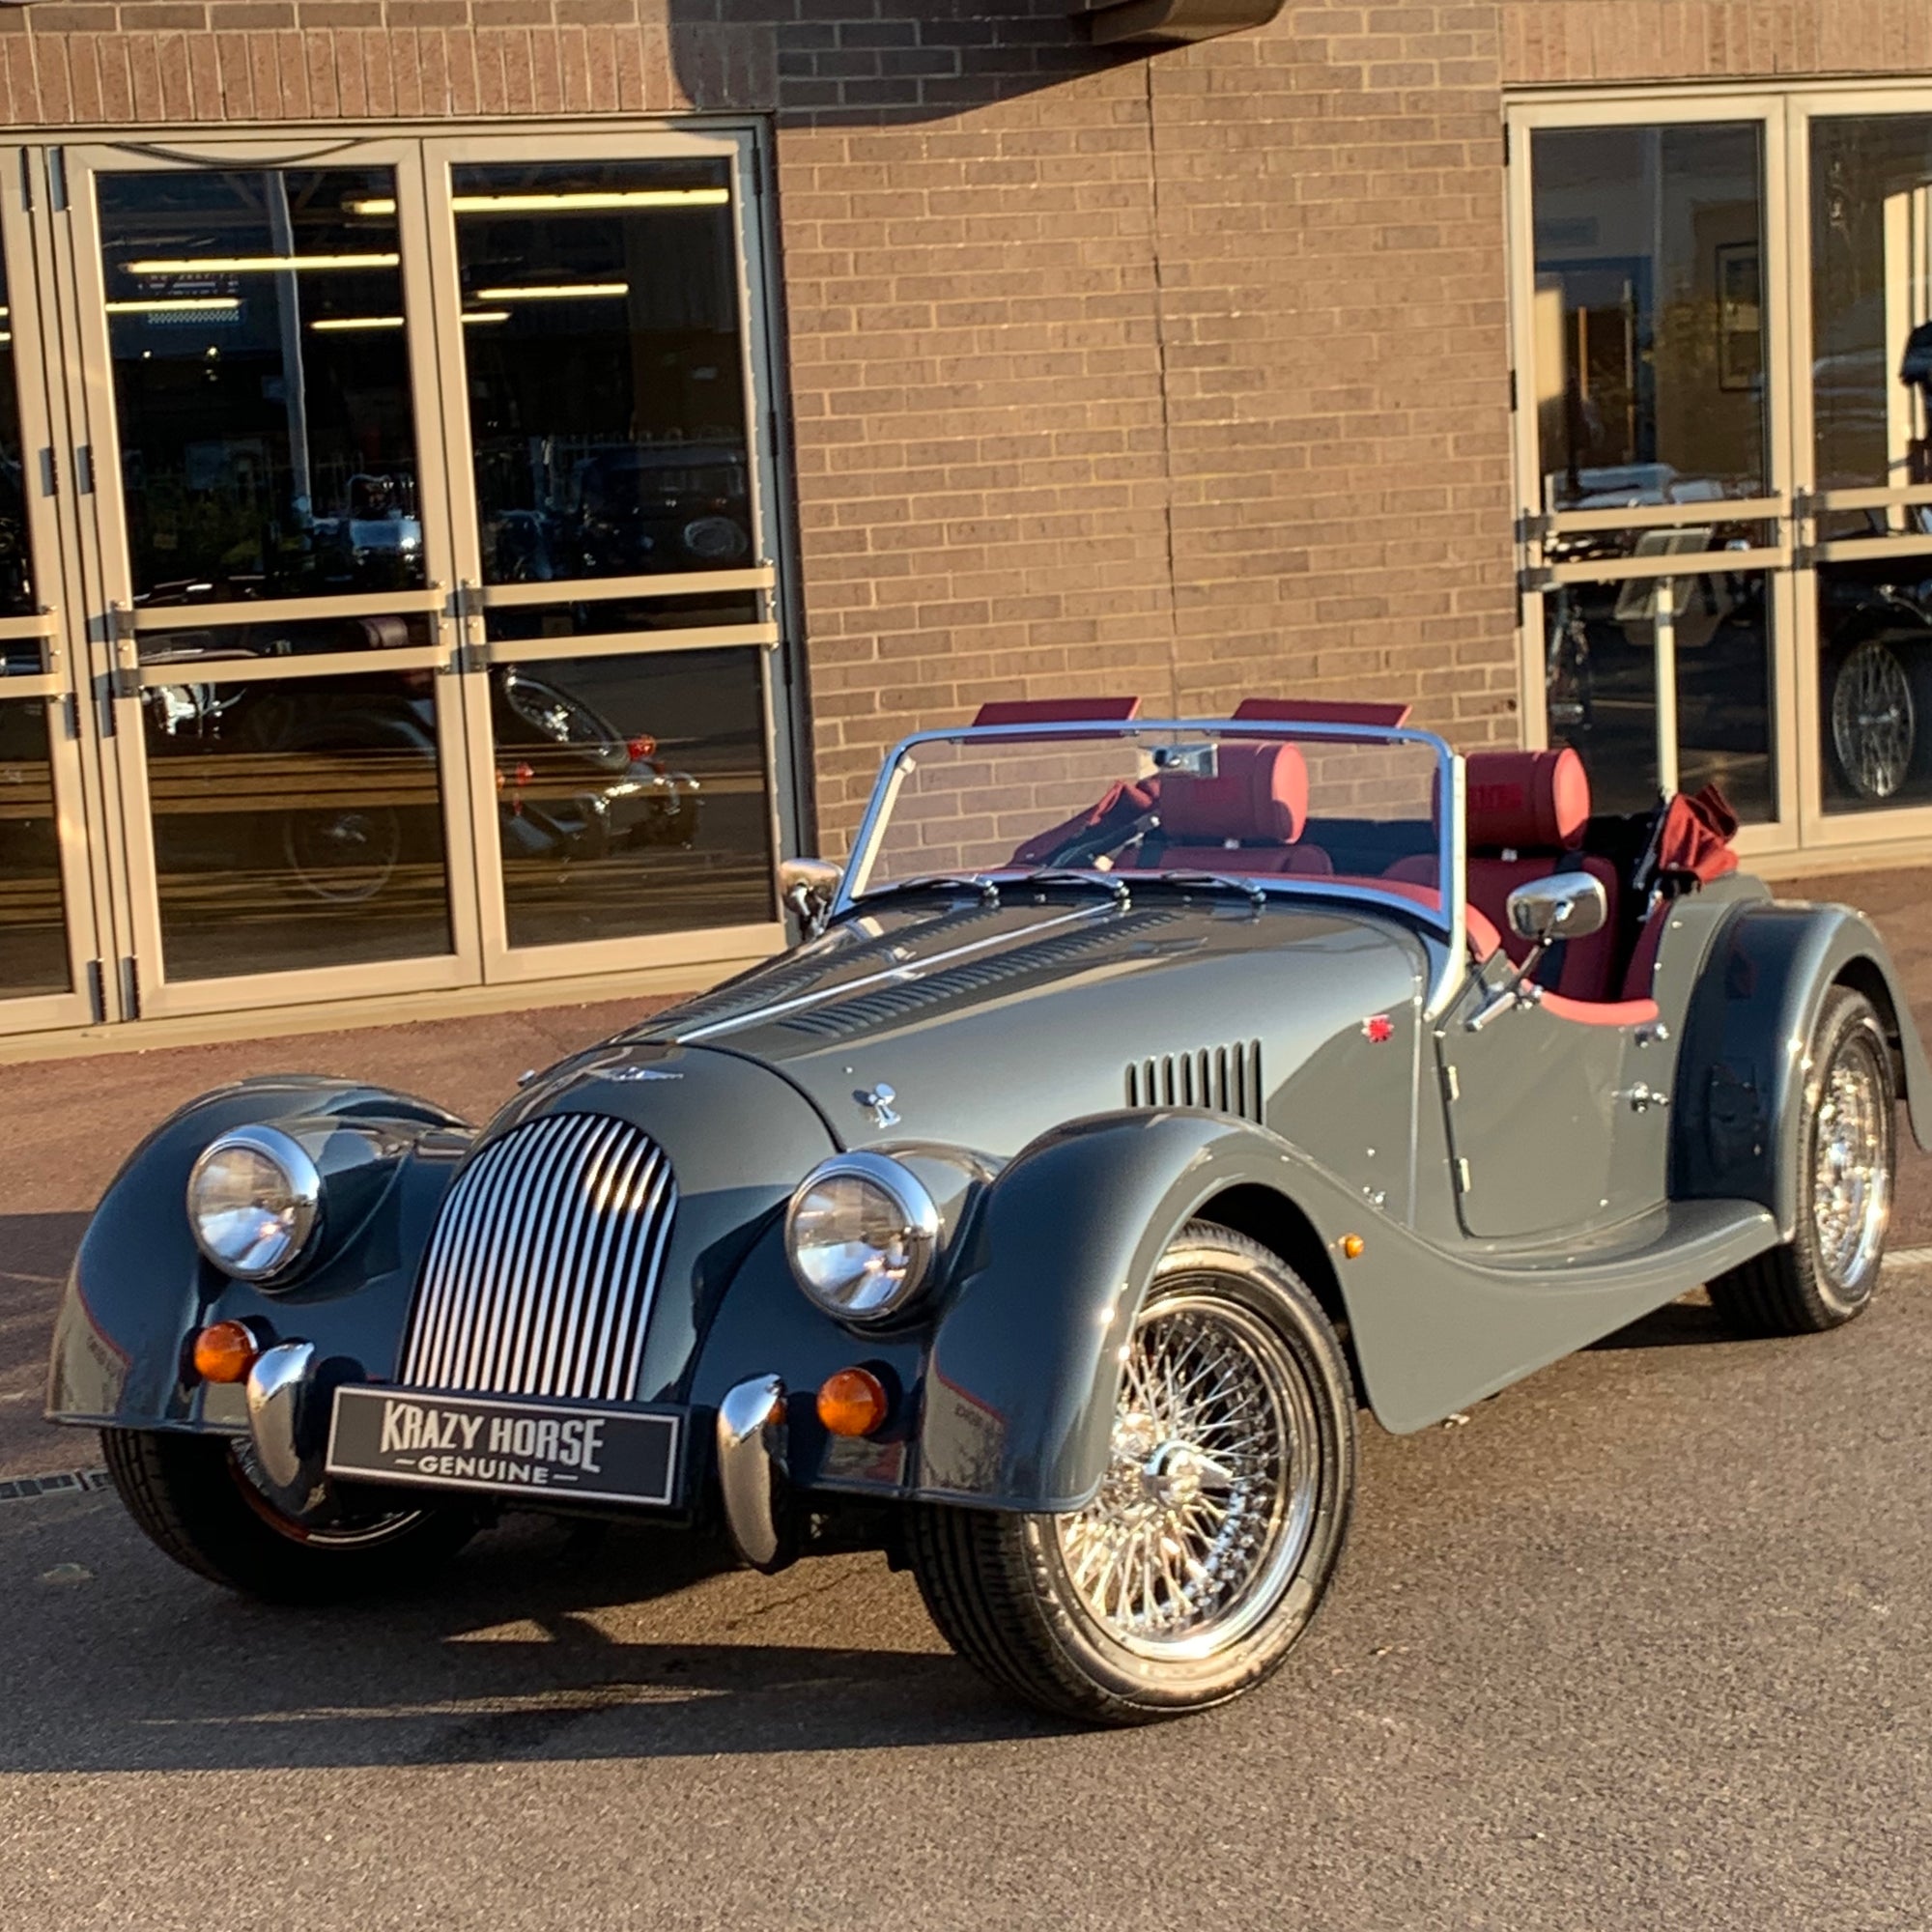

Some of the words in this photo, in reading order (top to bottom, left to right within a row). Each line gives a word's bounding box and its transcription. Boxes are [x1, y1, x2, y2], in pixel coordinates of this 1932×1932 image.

[381, 1400, 483, 1453] KRAZY
[490, 1417, 605, 1473] HORSE
[418, 1457, 549, 1484] GENUINE
